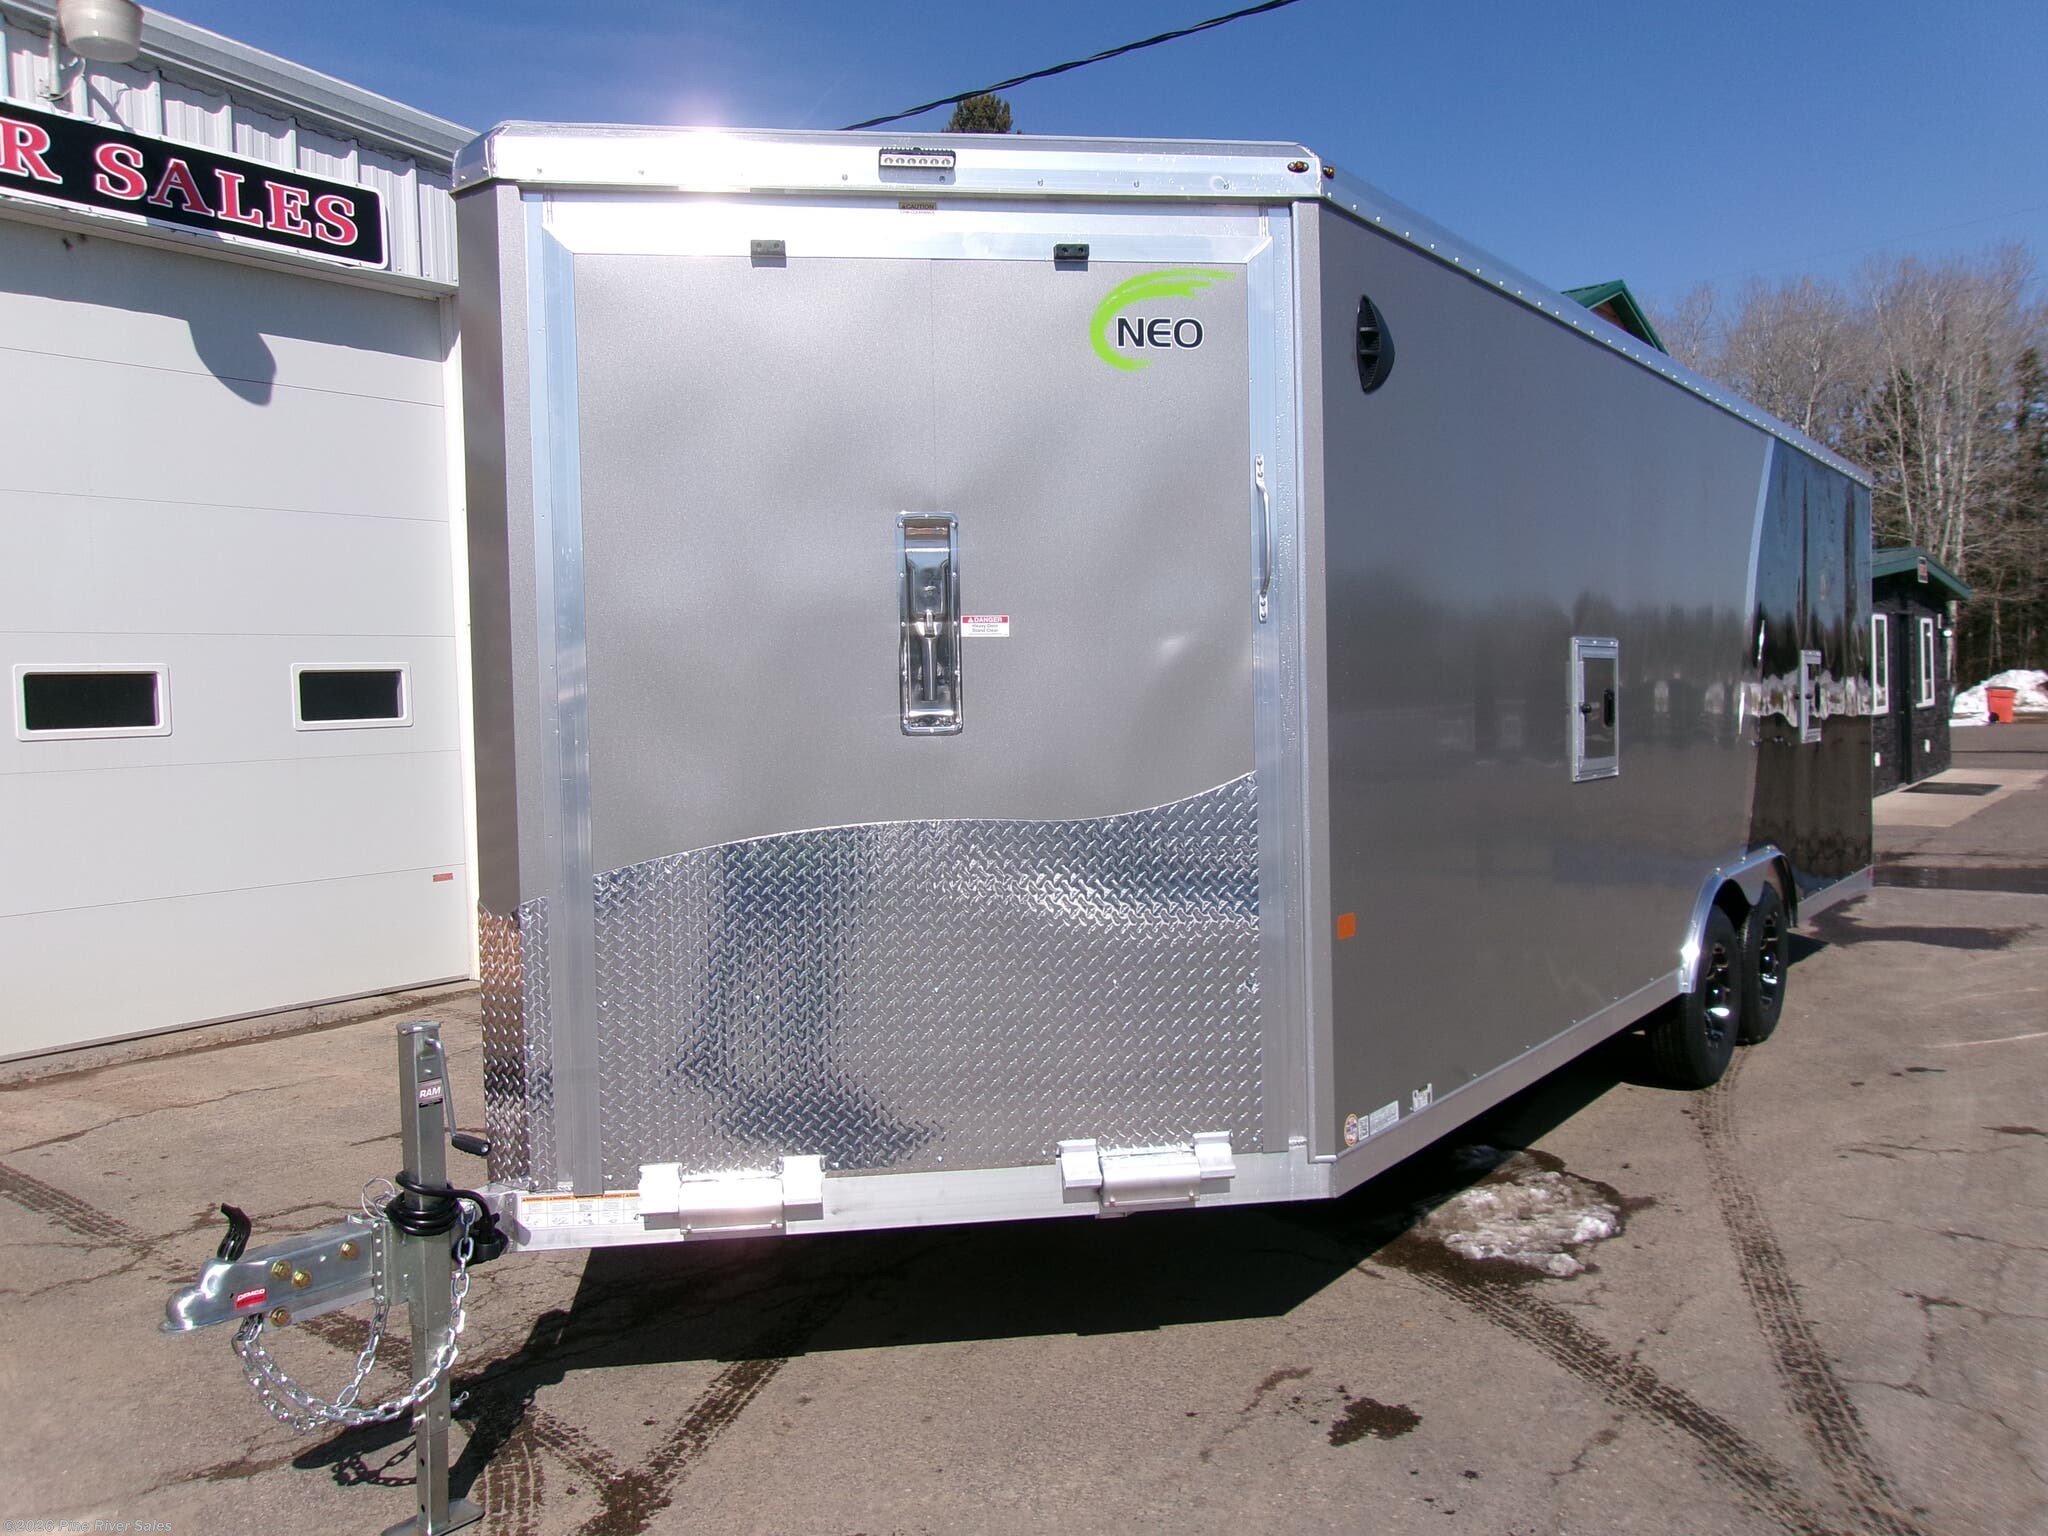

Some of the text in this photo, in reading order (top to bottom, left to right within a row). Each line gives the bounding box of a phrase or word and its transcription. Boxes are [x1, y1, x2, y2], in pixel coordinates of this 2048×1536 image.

[95, 142, 359, 247] SALES
[1116, 316, 1204, 350] NEO
[419, 1086, 441, 1098] RAM
